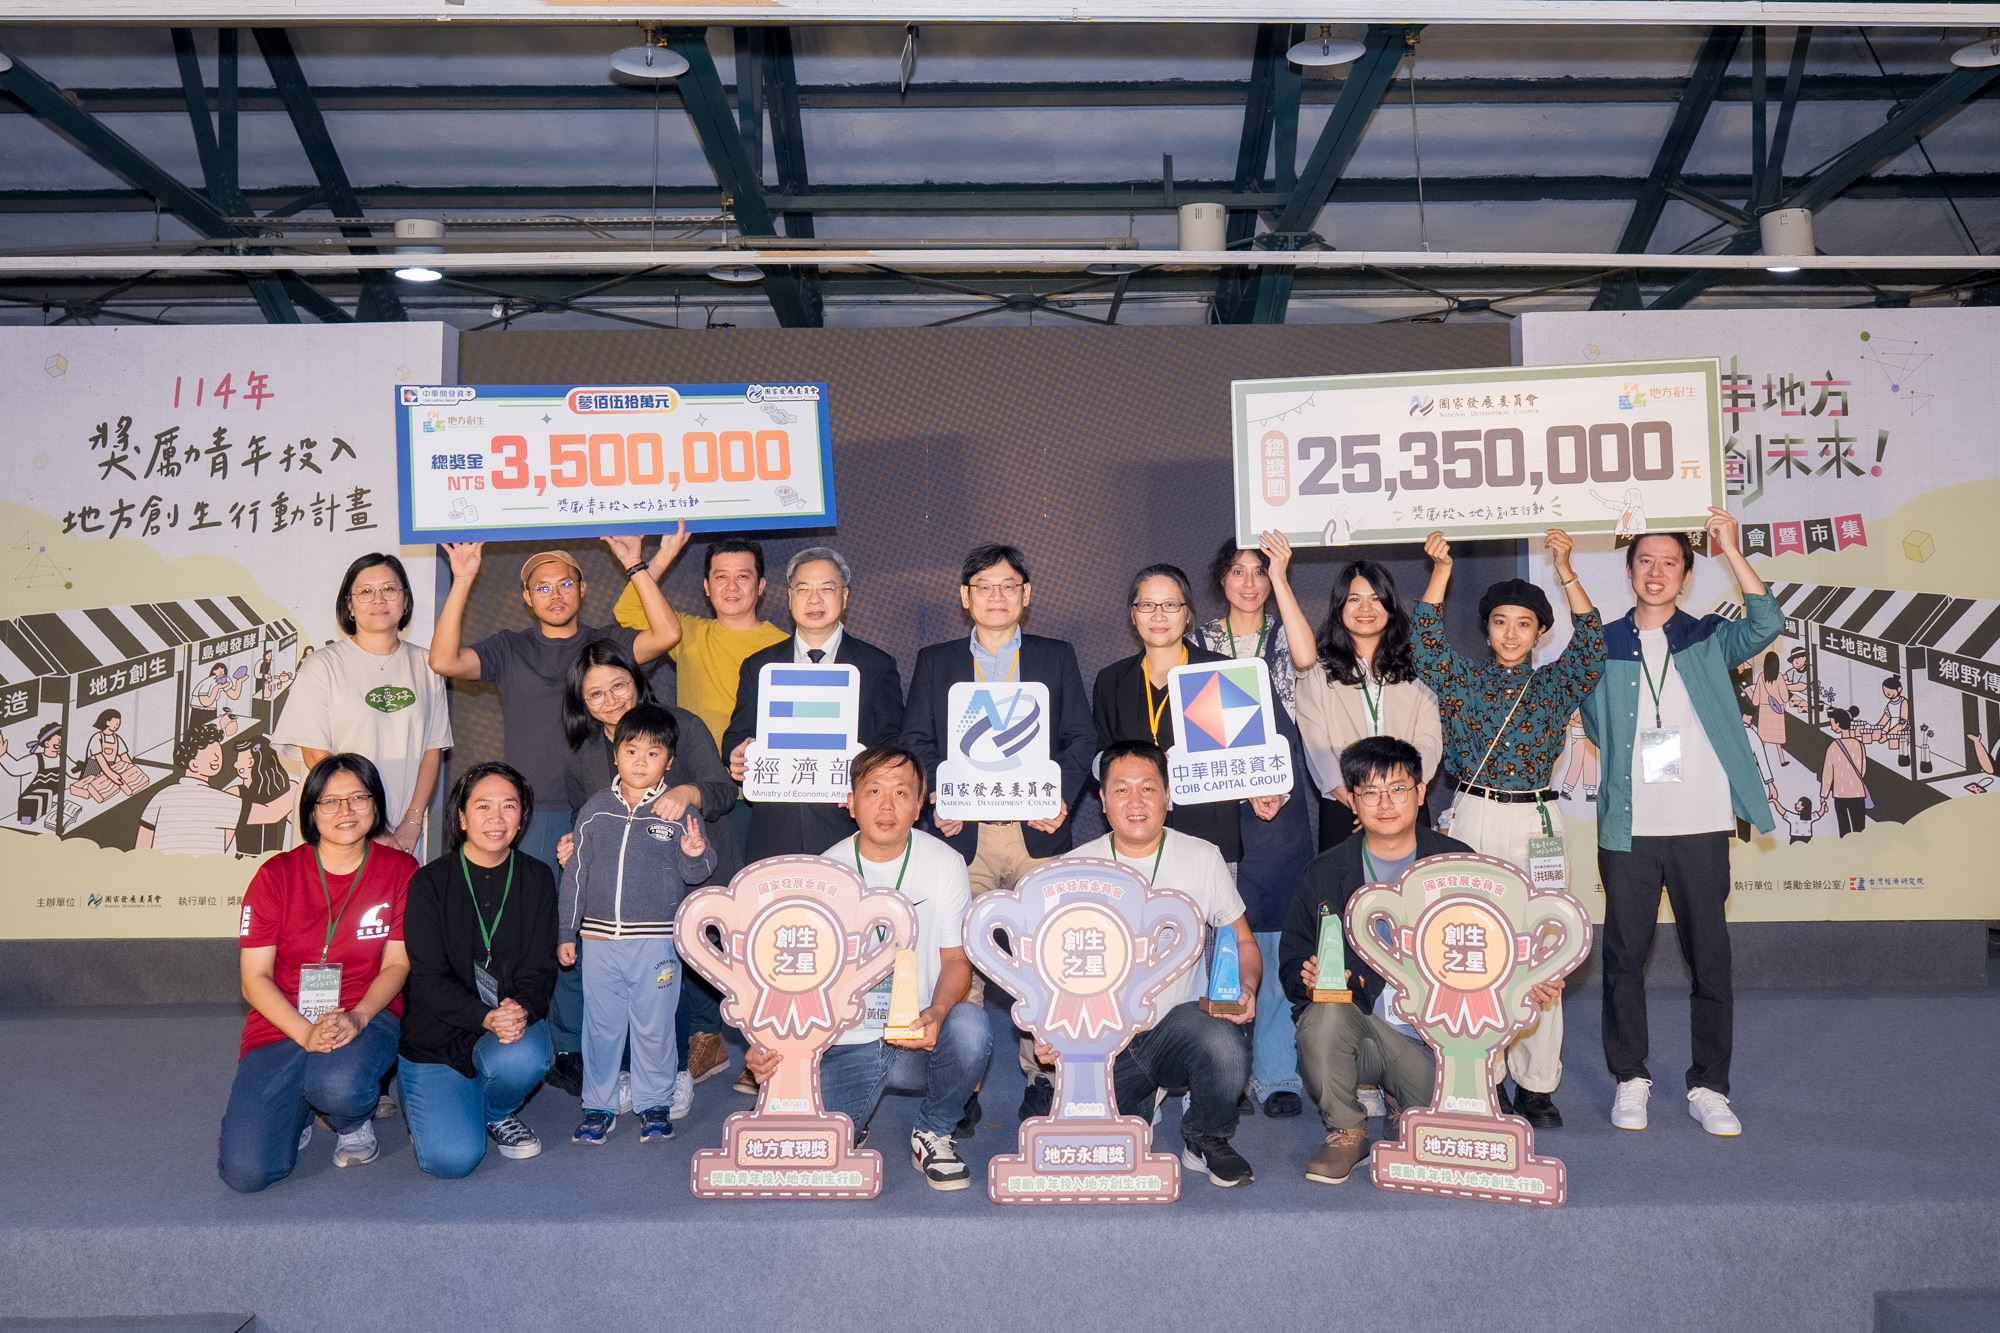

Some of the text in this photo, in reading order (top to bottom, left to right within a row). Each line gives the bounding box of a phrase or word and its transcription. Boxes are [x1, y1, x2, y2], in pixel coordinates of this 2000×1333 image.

[173, 371, 275, 410] 114年
[1439, 393, 1540, 410] 國家發展委員會
[1649, 386, 1697, 399] 地方創生
[431, 454, 484, 470] 總獎金
[490, 429, 791, 497] 3,500,000
[1297, 420, 1674, 501] 25,350,000
[62, 486, 378, 539] 地方創生行動計畫
[201, 632, 257, 661] 島嶼發酵
[1825, 632, 1888, 664] 土地記憶
[89, 658, 168, 697] 地方創生
[0, 690, 28, 718] 造
[1172, 754, 1286, 782] 中華開發資本
[752, 789, 783, 798] Ministry
[784, 789, 791, 798] of
[792, 789, 829, 798] Economic
[941, 781, 1057, 798] 國家發展委員會
[1175, 773, 1287, 795] CDIB CAPITAL GROUP
[1734, 880, 1773, 891] 執行單位
[36, 897, 75, 908] 主辦單位
[178, 896, 217, 907] 執行單位
[775, 924, 817, 949] 創生
[1063, 927, 1106, 952] 創生
[1443, 924, 1487, 948] 創生
[775, 951, 817, 975] 之星
[1063, 953, 1106, 978] 之星
[1443, 950, 1487, 974] 之星
[866, 1008, 889, 1020] 黃信
[747, 1140, 829, 1159] 地方實現獎
[1044, 1145, 1125, 1165] 地方永續獎
[1424, 1135, 1507, 1162] 地方新芽獎
